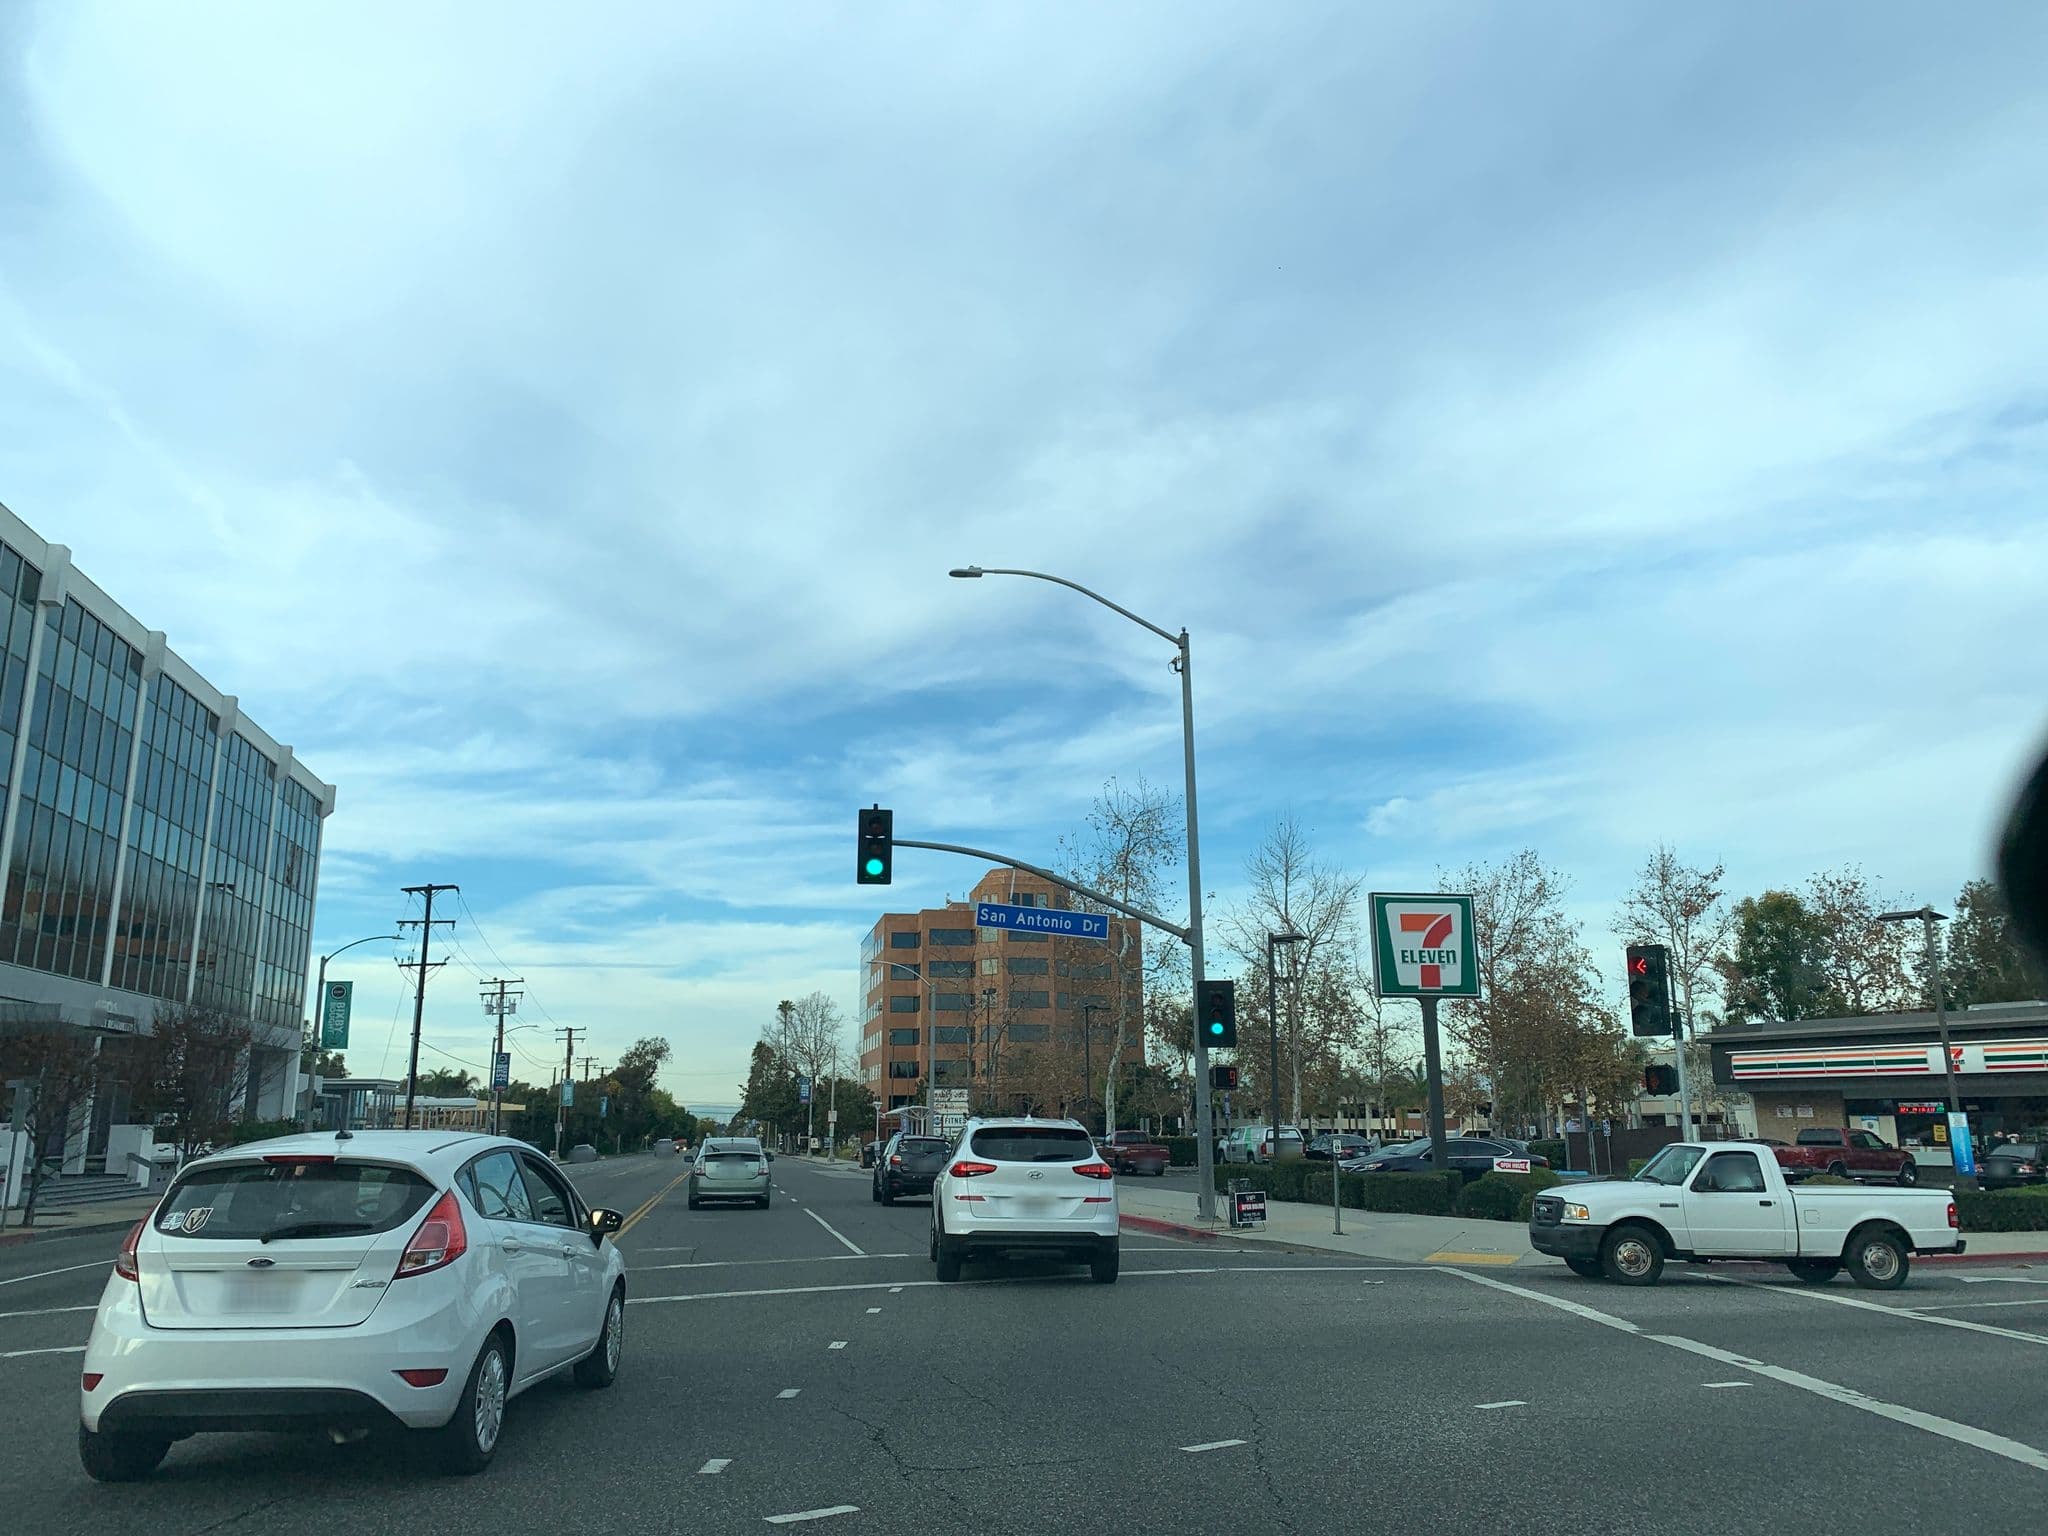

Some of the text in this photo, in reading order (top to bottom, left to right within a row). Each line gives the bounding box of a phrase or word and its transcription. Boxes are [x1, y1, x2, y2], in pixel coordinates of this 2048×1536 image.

[980, 908, 1100, 933] San Antonio Dr
[1400, 913, 1453, 988] 7
[334, 1002, 346, 1034] BIXBY
[1230, 1070, 1236, 1086] 9
